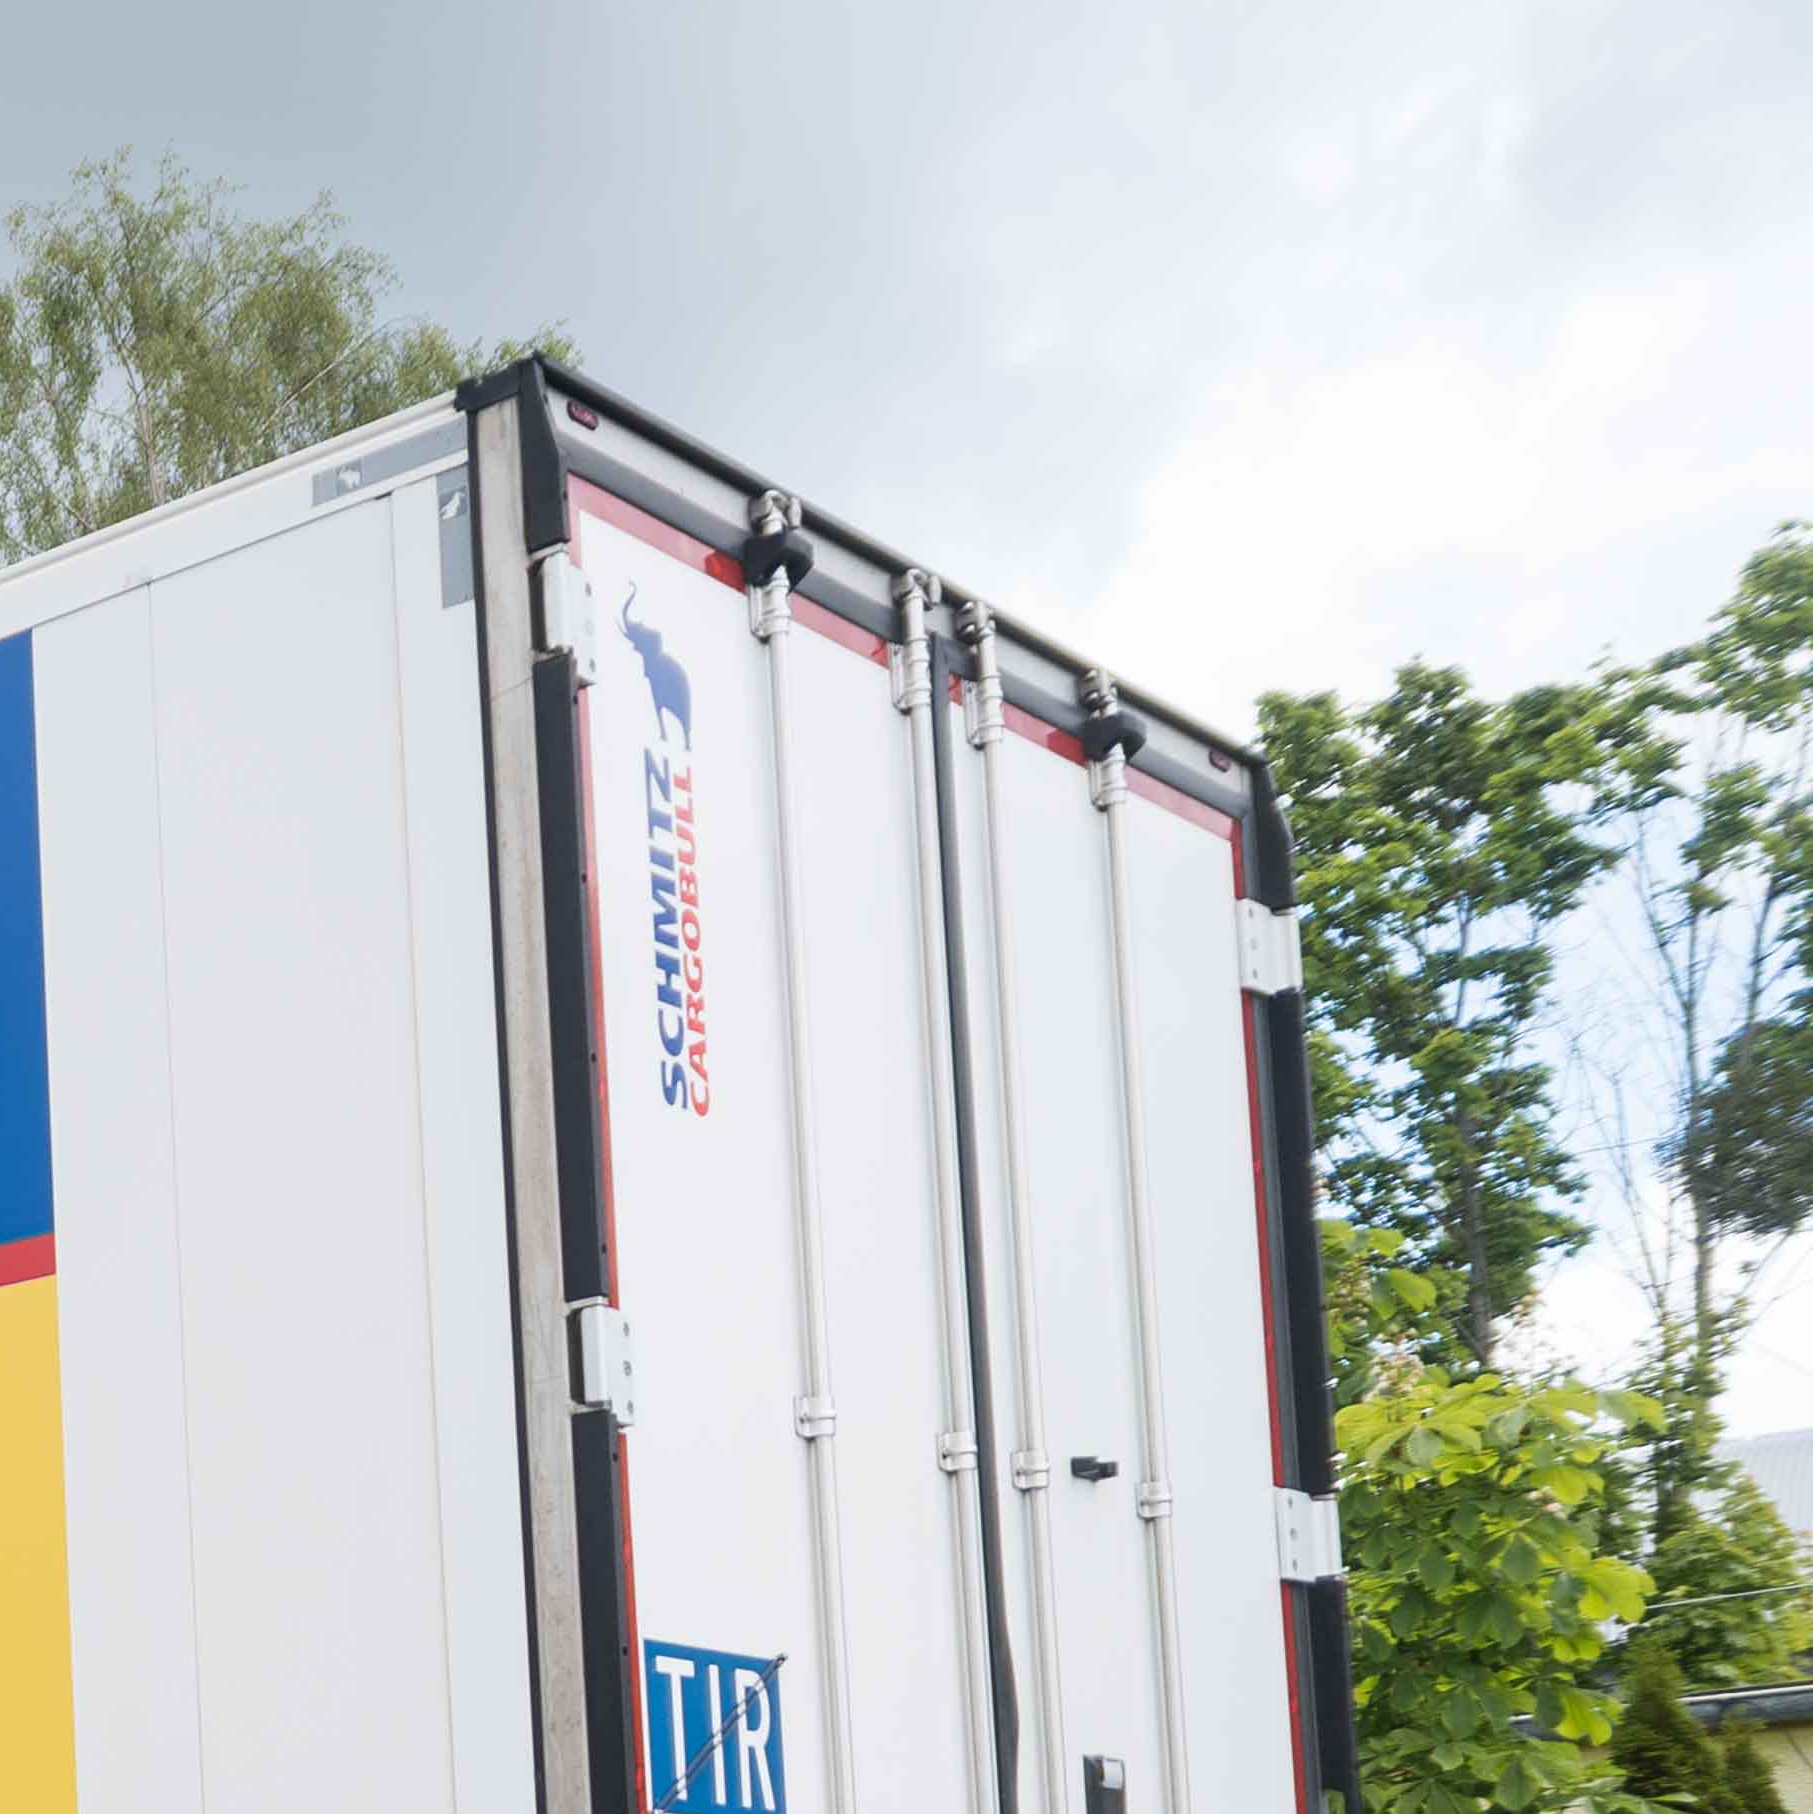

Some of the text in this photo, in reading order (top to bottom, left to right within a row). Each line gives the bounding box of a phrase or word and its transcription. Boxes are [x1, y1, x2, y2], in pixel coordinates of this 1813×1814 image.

[644, 748, 688, 1111] SCHMITZ
[674, 767, 709, 1117] CARGOBULL
[655, 1655, 776, 1812] TIR
